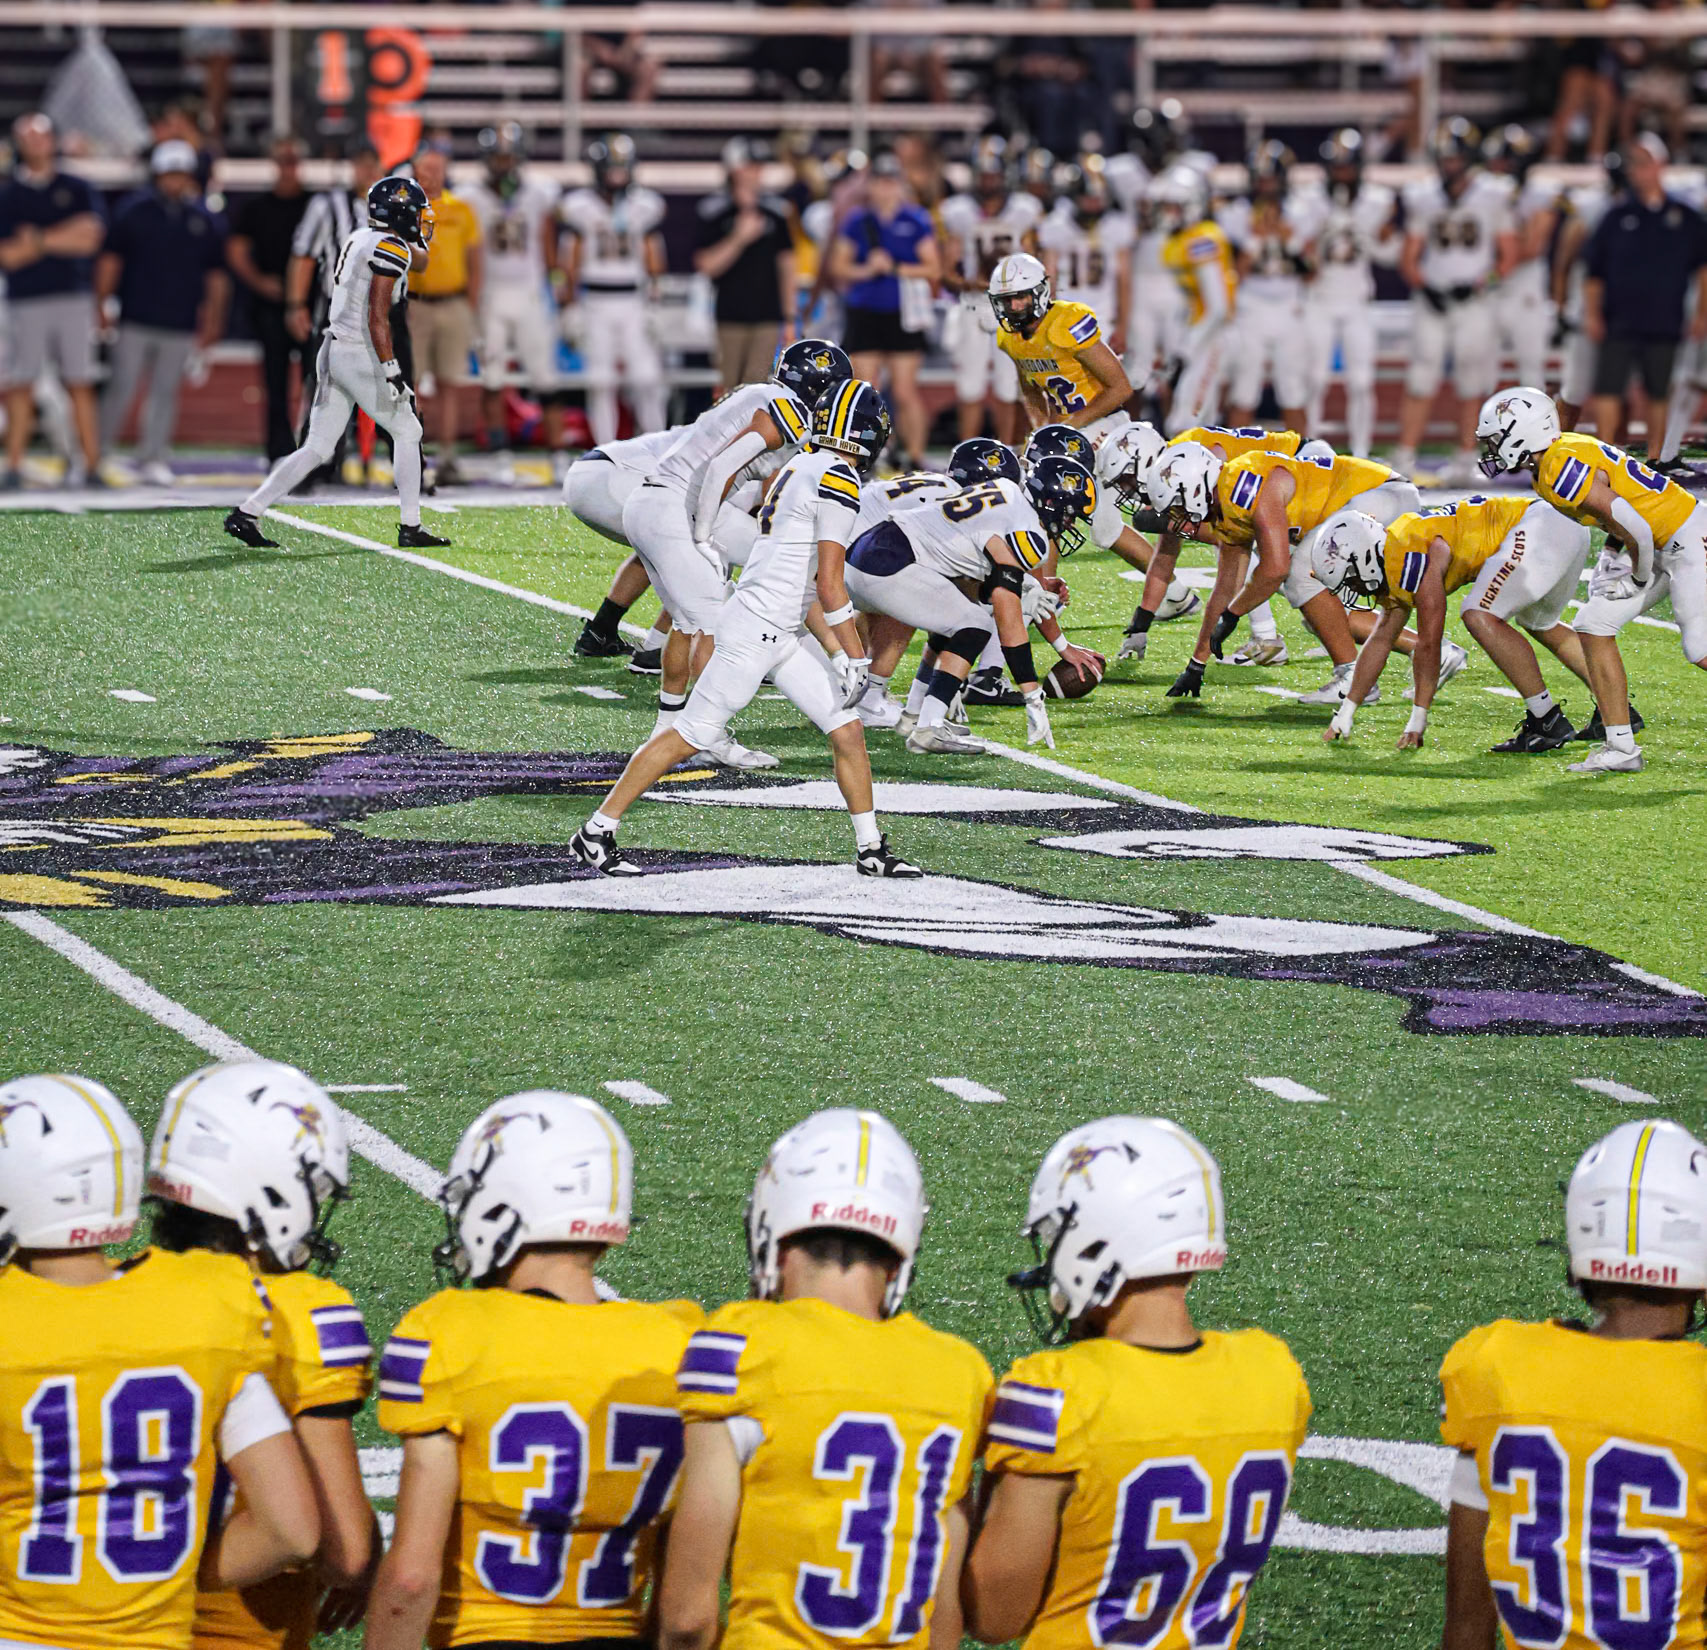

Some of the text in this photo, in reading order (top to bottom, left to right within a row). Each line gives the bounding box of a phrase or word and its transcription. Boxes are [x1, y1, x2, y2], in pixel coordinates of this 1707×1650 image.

[818, 435, 861, 454] GRAND HAVEN
[1479, 530, 1526, 611] FIGHTING SCOTS
[811, 1201, 898, 1236] Riddell
[1590, 1258, 1678, 1287] Riddell
[17, 1365, 204, 1585] 18
[472, 1400, 687, 1609] 37
[794, 1410, 964, 1643] 31
[1088, 1449, 1293, 1650] 68
[1489, 1425, 1688, 1650] 36
